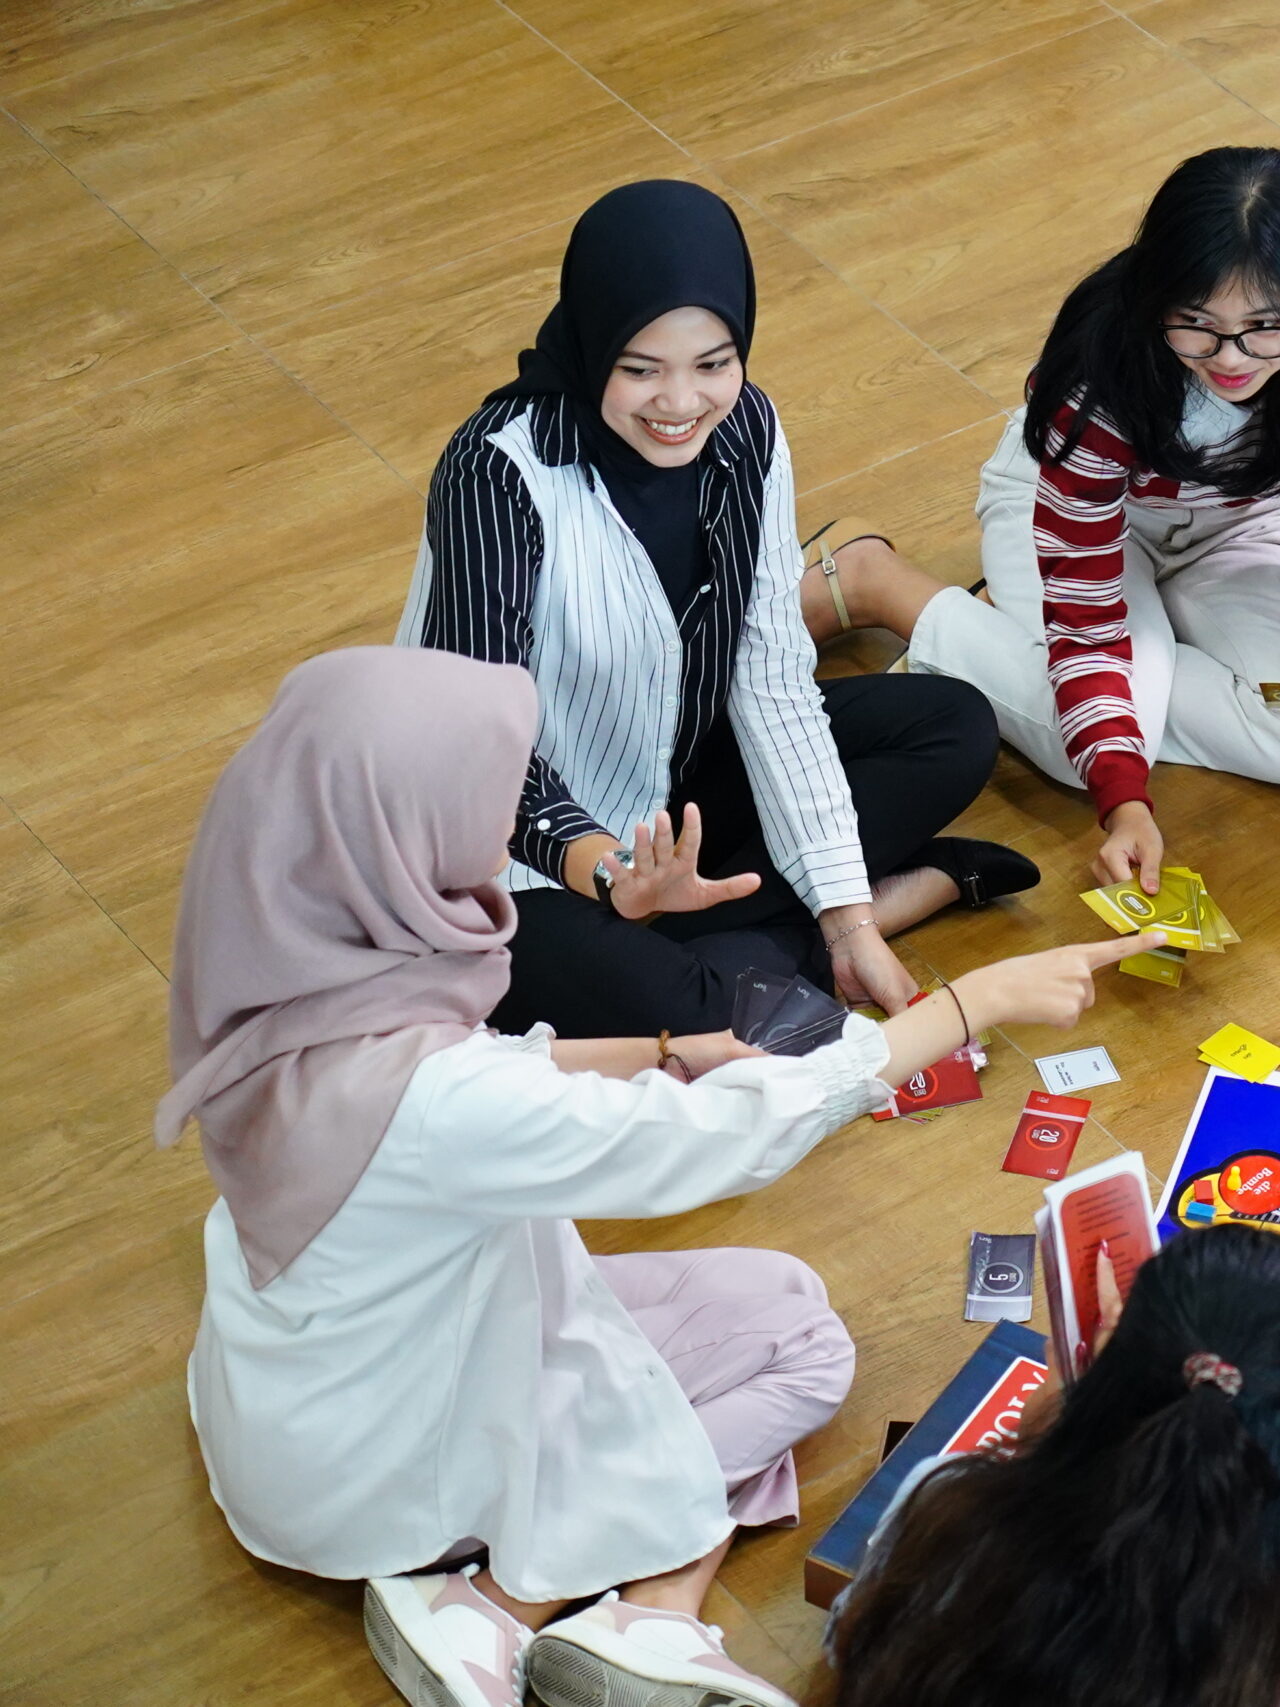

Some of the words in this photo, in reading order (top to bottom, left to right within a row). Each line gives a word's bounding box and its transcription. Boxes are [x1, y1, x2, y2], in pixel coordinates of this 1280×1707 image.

[1039, 1129, 1060, 1143] 20
[1236, 1167, 1274, 1196] Bombe
[1254, 1181, 1271, 1195] die
[989, 1273, 1008, 1281] 5
